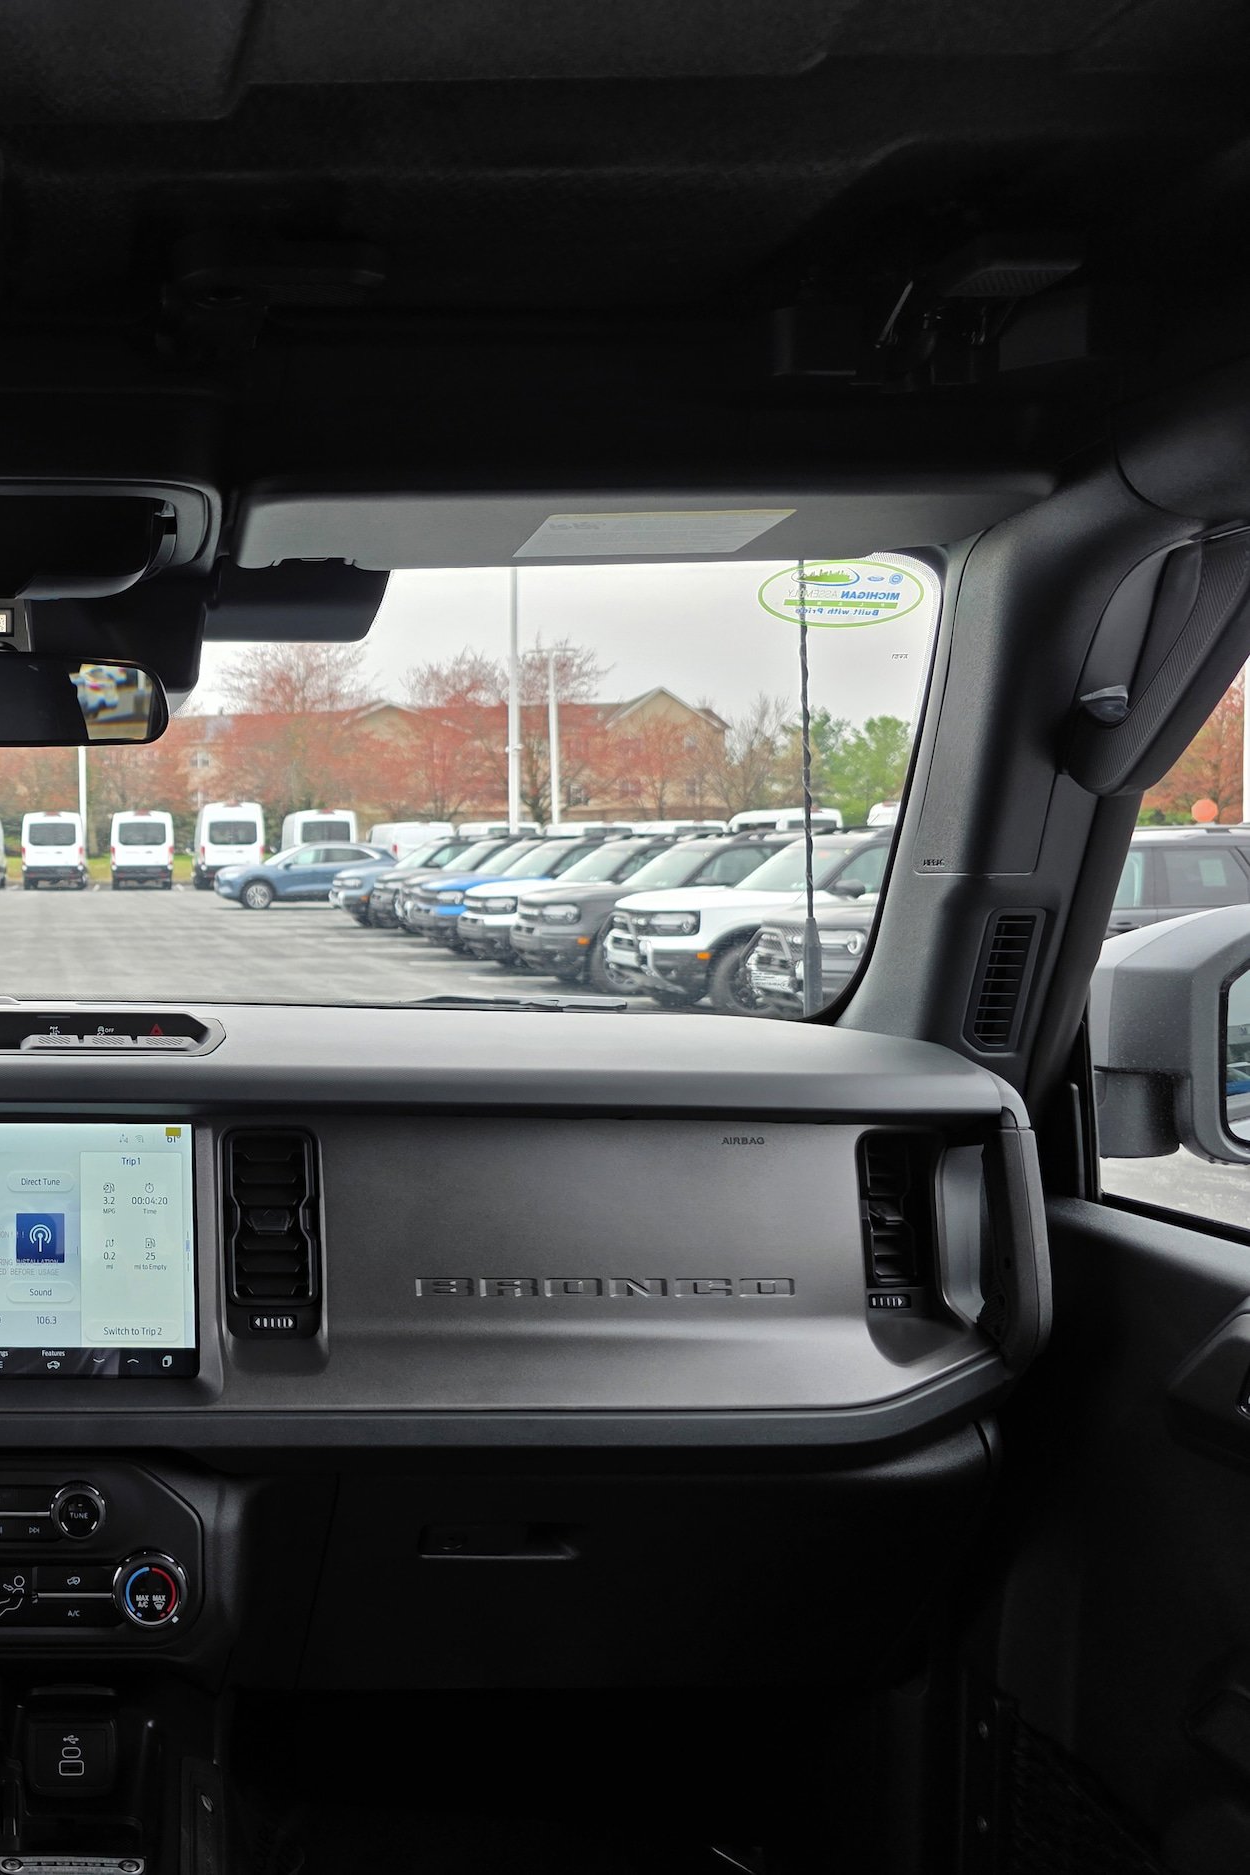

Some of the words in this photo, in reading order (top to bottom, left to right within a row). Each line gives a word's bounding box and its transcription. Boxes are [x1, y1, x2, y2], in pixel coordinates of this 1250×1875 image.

[721, 1136, 765, 1145] AIRBAG
[121, 1157, 137, 1167] Trip
[20, 1177, 41, 1186] Direct
[42, 1177, 61, 1186] Tune
[103, 1196, 115, 1205] 3.2
[131, 1196, 168, 1205] 00:04:20
[103, 1251, 116, 1260] 0.2
[145, 1251, 156, 1260] 25
[149, 1263, 167, 1271] Empty
[10, 1268, 35, 1276] BEFORE
[38, 1268, 60, 1276] USAGE
[415, 1276, 796, 1299] BRONCO
[29, 1288, 52, 1297] Sound
[36, 1315, 57, 1325] 106.3
[103, 1326, 130, 1336] Switch
[131, 1326, 140, 1336] to
[141, 1326, 156, 1337] Trip
[157, 1327, 163, 1336] 2
[41, 1349, 66, 1357] Features
[135, 1594, 150, 1602] MAX
[152, 1594, 166, 1602] MAX
[137, 1601, 149, 1609] A/C
[67, 1609, 81, 1618] A/C
